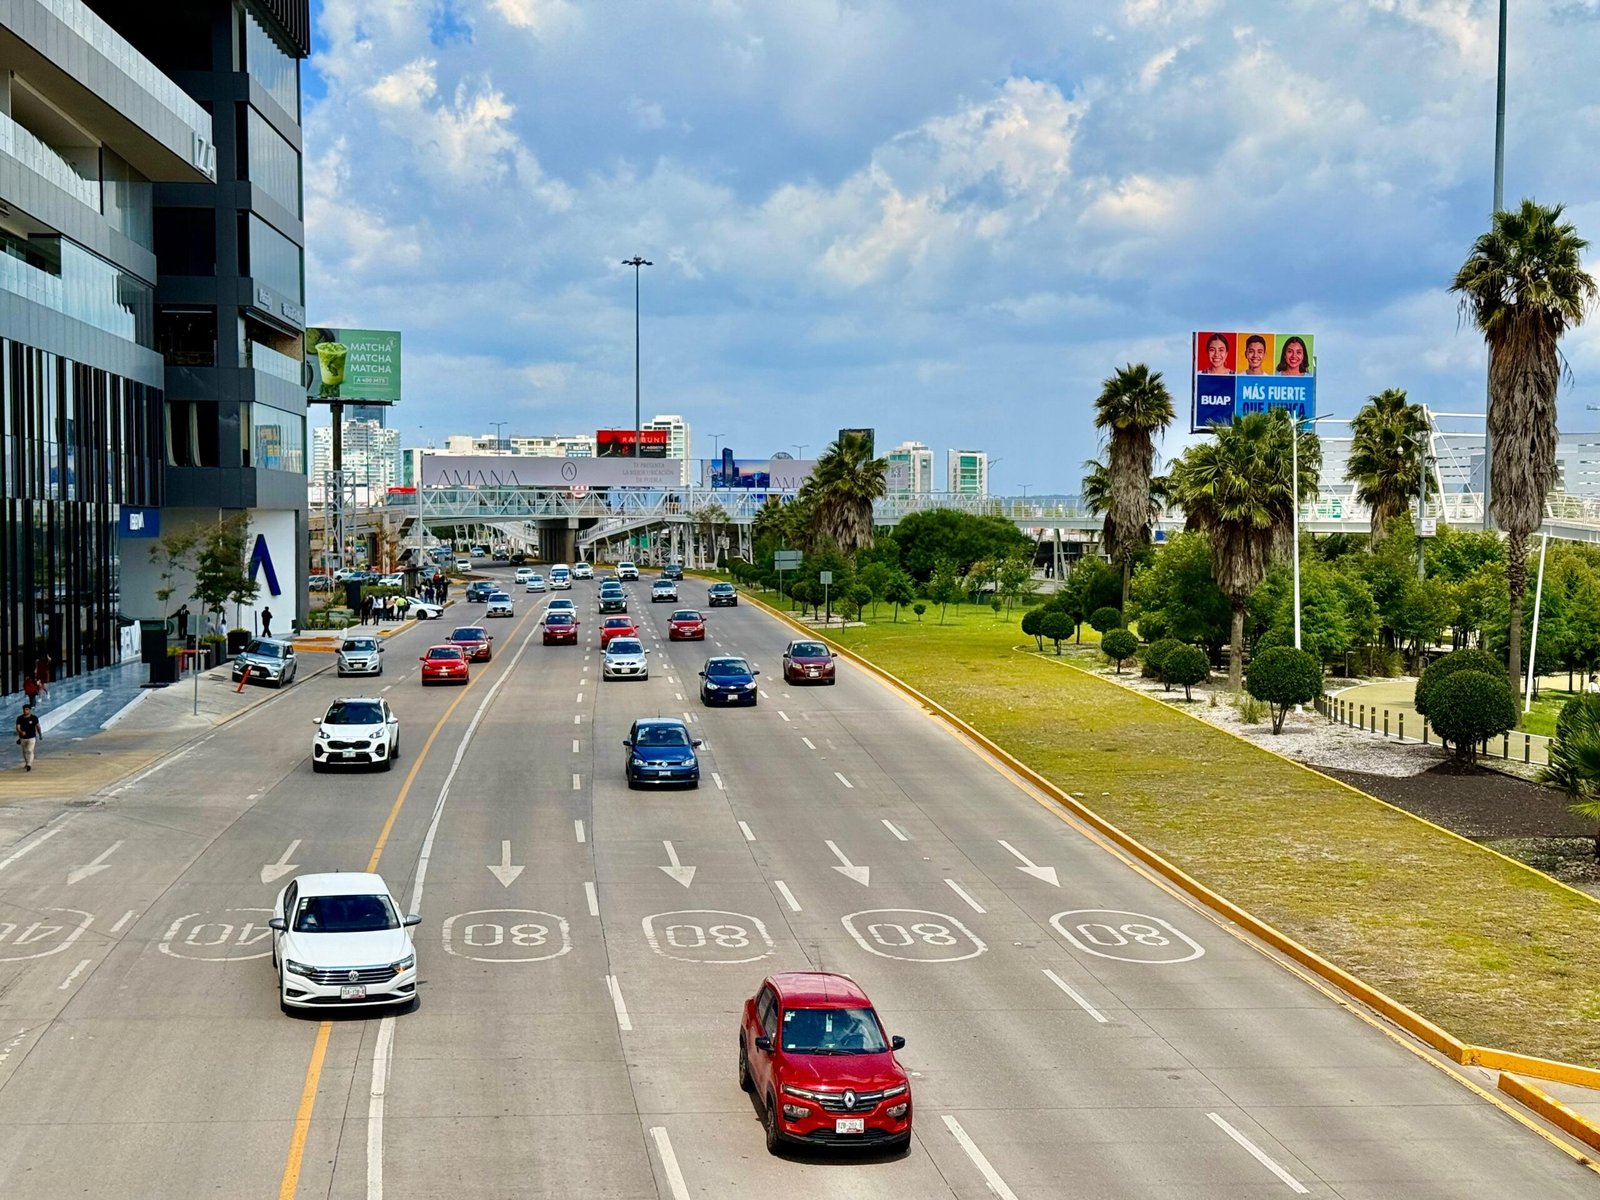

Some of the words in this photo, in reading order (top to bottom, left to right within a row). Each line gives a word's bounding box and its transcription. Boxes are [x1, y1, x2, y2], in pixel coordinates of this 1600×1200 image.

[350, 343, 392, 352] MATCHA
[350, 354, 392, 363] MATCHA
[350, 364, 392, 373] MATCHA
[1201, 395, 1230, 405] BUAP
[1242, 383, 1265, 400] MÁS
[1268, 386, 1306, 401] FUERTE
[1242, 402, 1264, 416] QUE
[463, 923, 549, 946] 80
[665, 924, 749, 948] 80
[867, 923, 957, 946] 80
[1076, 923, 1170, 946] 80
